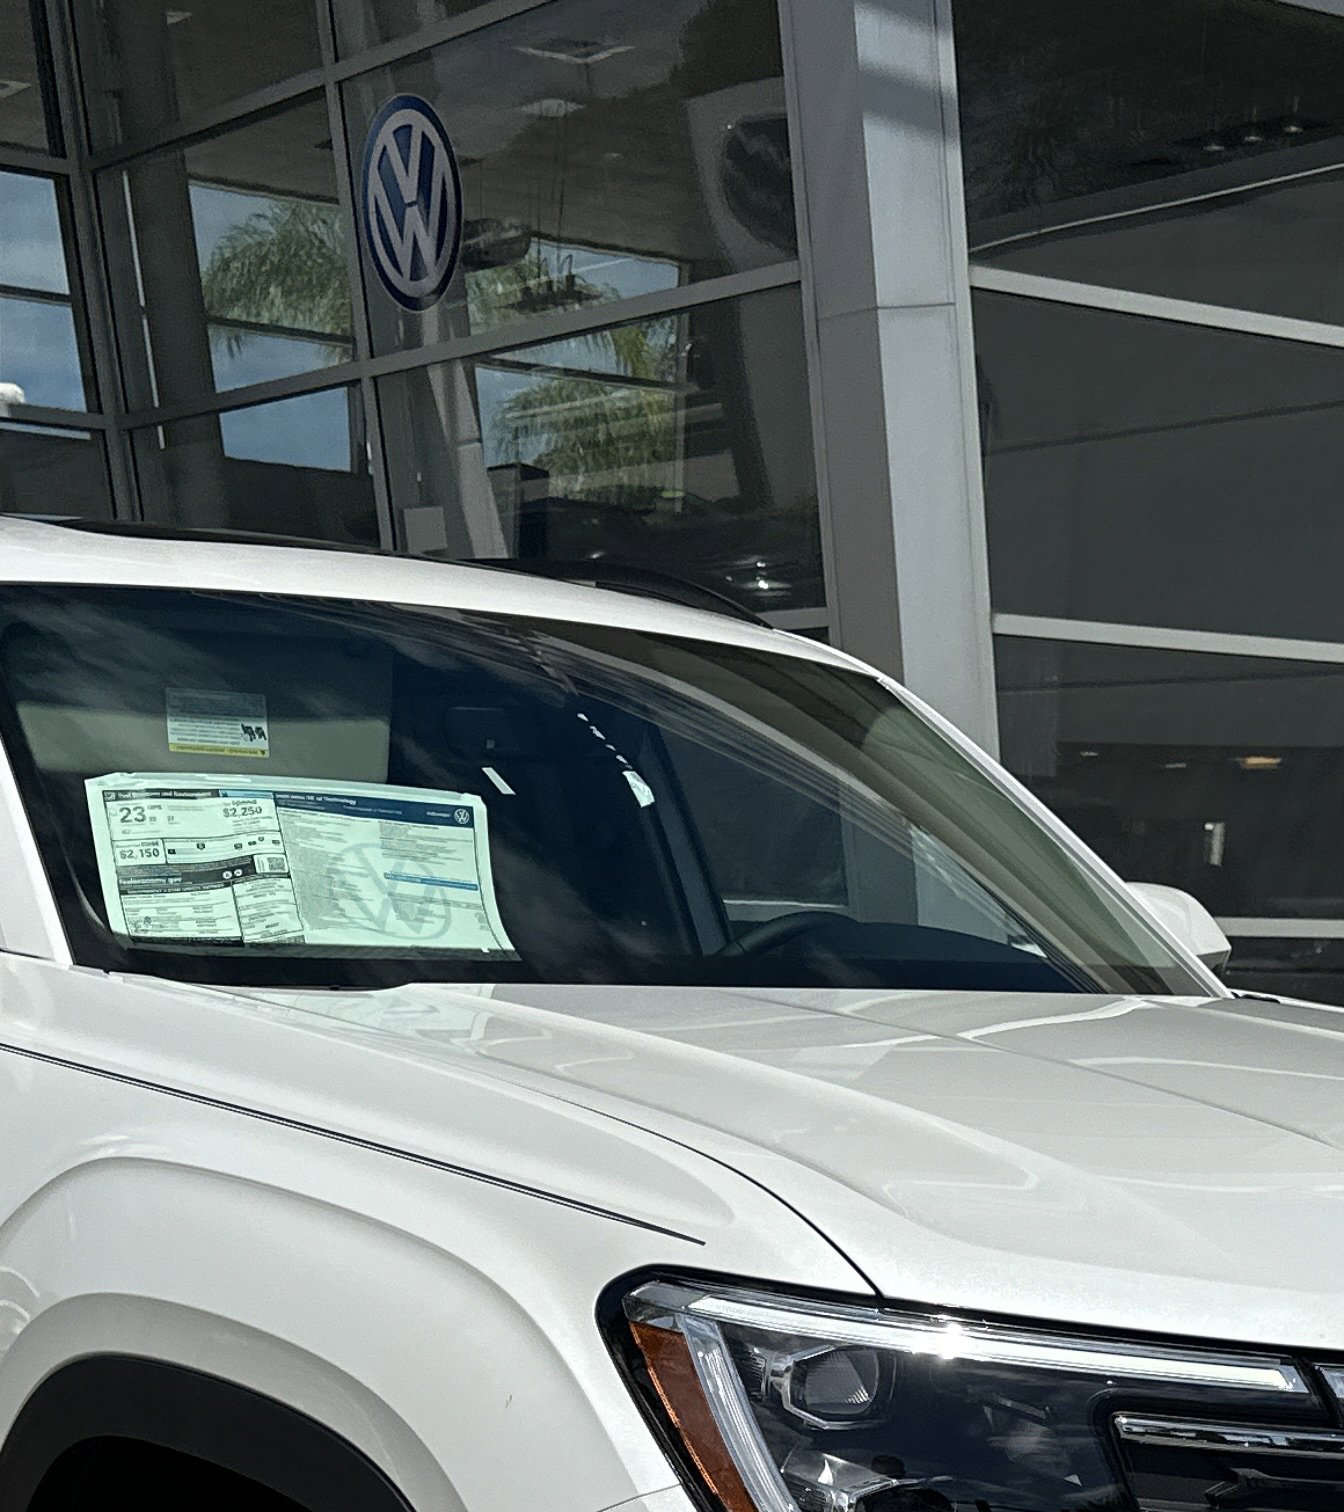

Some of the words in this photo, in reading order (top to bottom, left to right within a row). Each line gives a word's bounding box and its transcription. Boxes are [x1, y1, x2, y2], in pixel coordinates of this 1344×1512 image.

[368, 110, 455, 297] VW
[119, 806, 146, 823] 23
[223, 805, 262, 818] $2,250
[119, 847, 160, 860] $2,150
